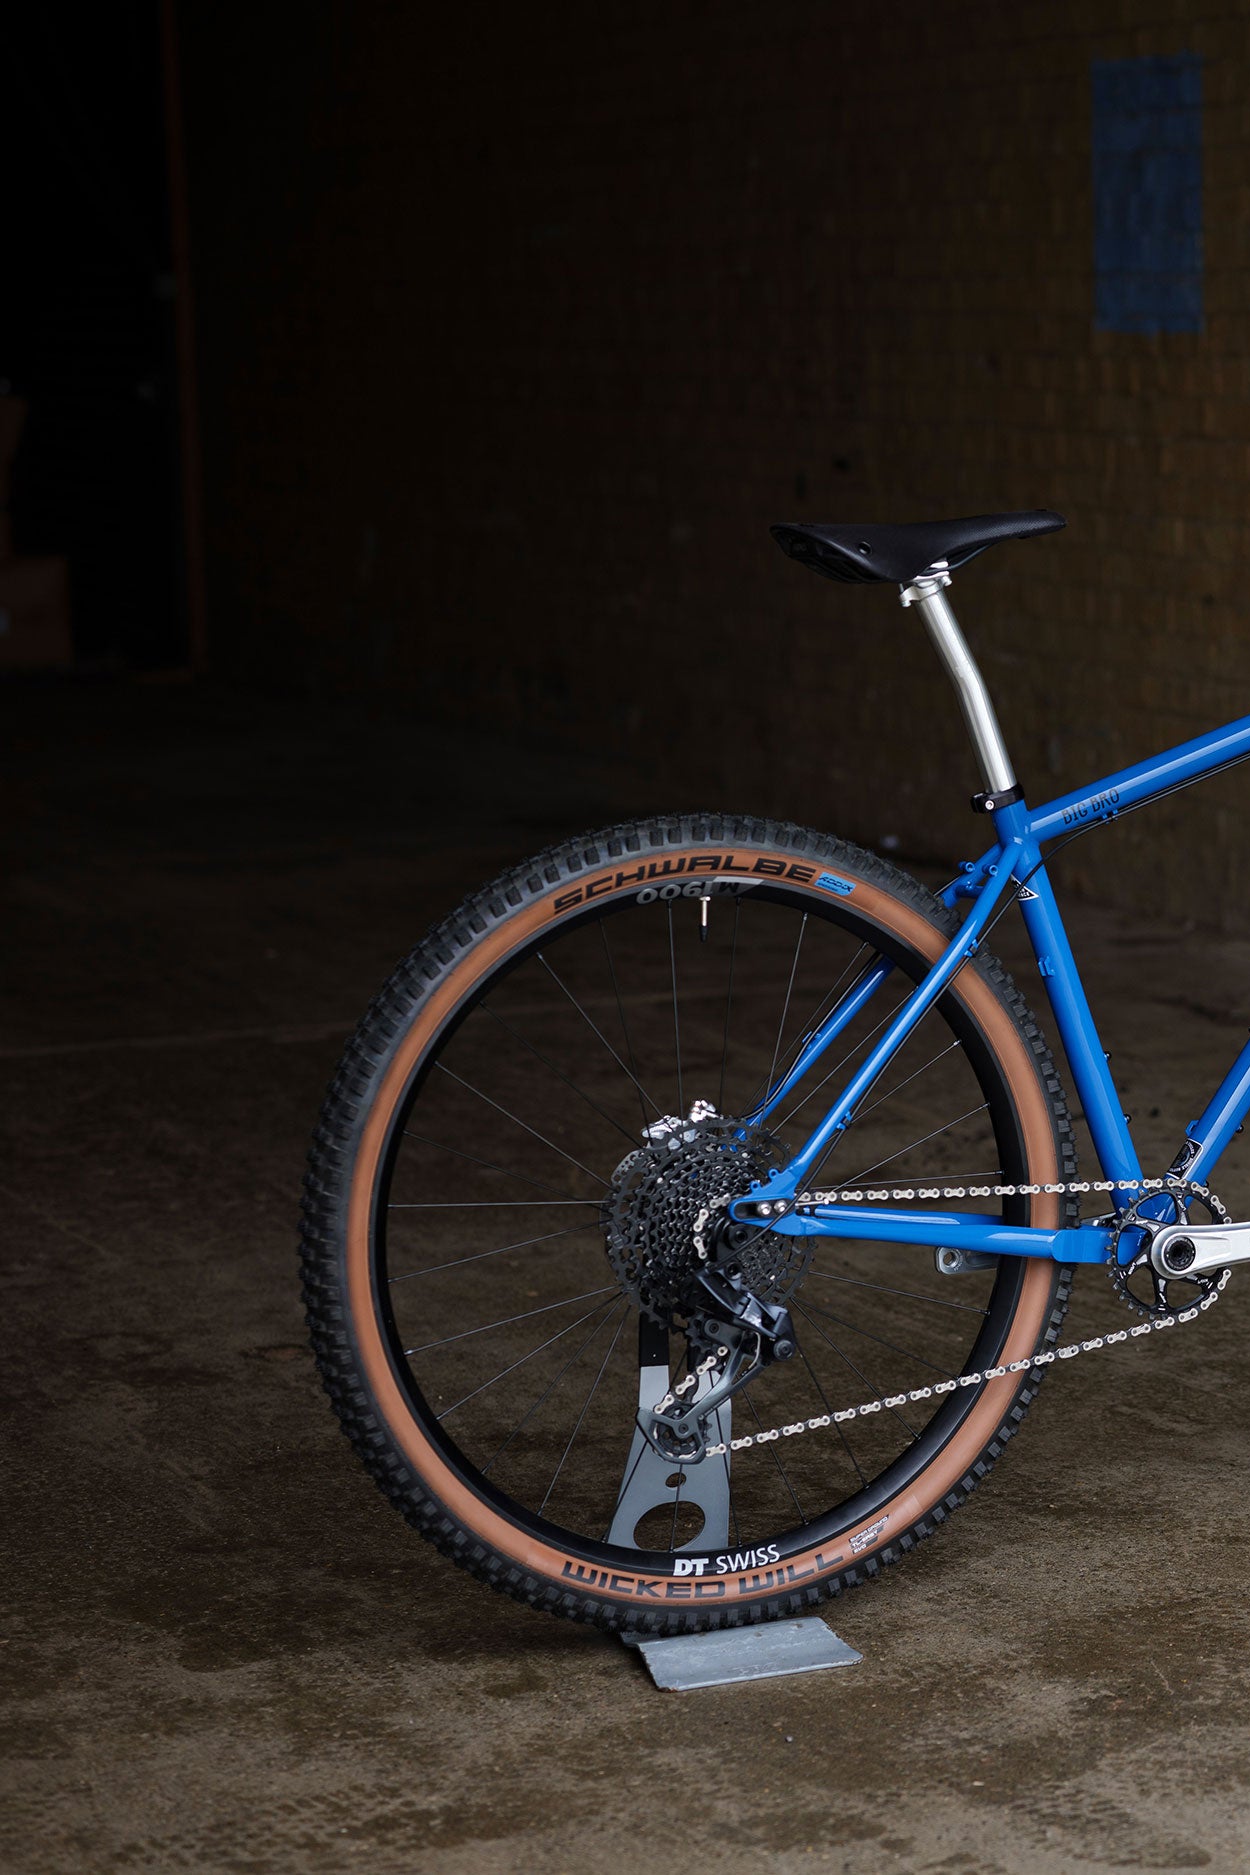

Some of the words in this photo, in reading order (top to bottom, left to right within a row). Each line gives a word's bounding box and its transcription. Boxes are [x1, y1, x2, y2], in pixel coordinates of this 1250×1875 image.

[1060, 802, 1088, 825] BIG
[1089, 788, 1120, 812] BRO
[554, 855, 817, 915] SCHWALBE
[562, 1561, 726, 1599] WICKED
[738, 1553, 844, 1595] WILL
[673, 1557, 710, 1577] DT
[715, 1544, 781, 1575] SWISS
